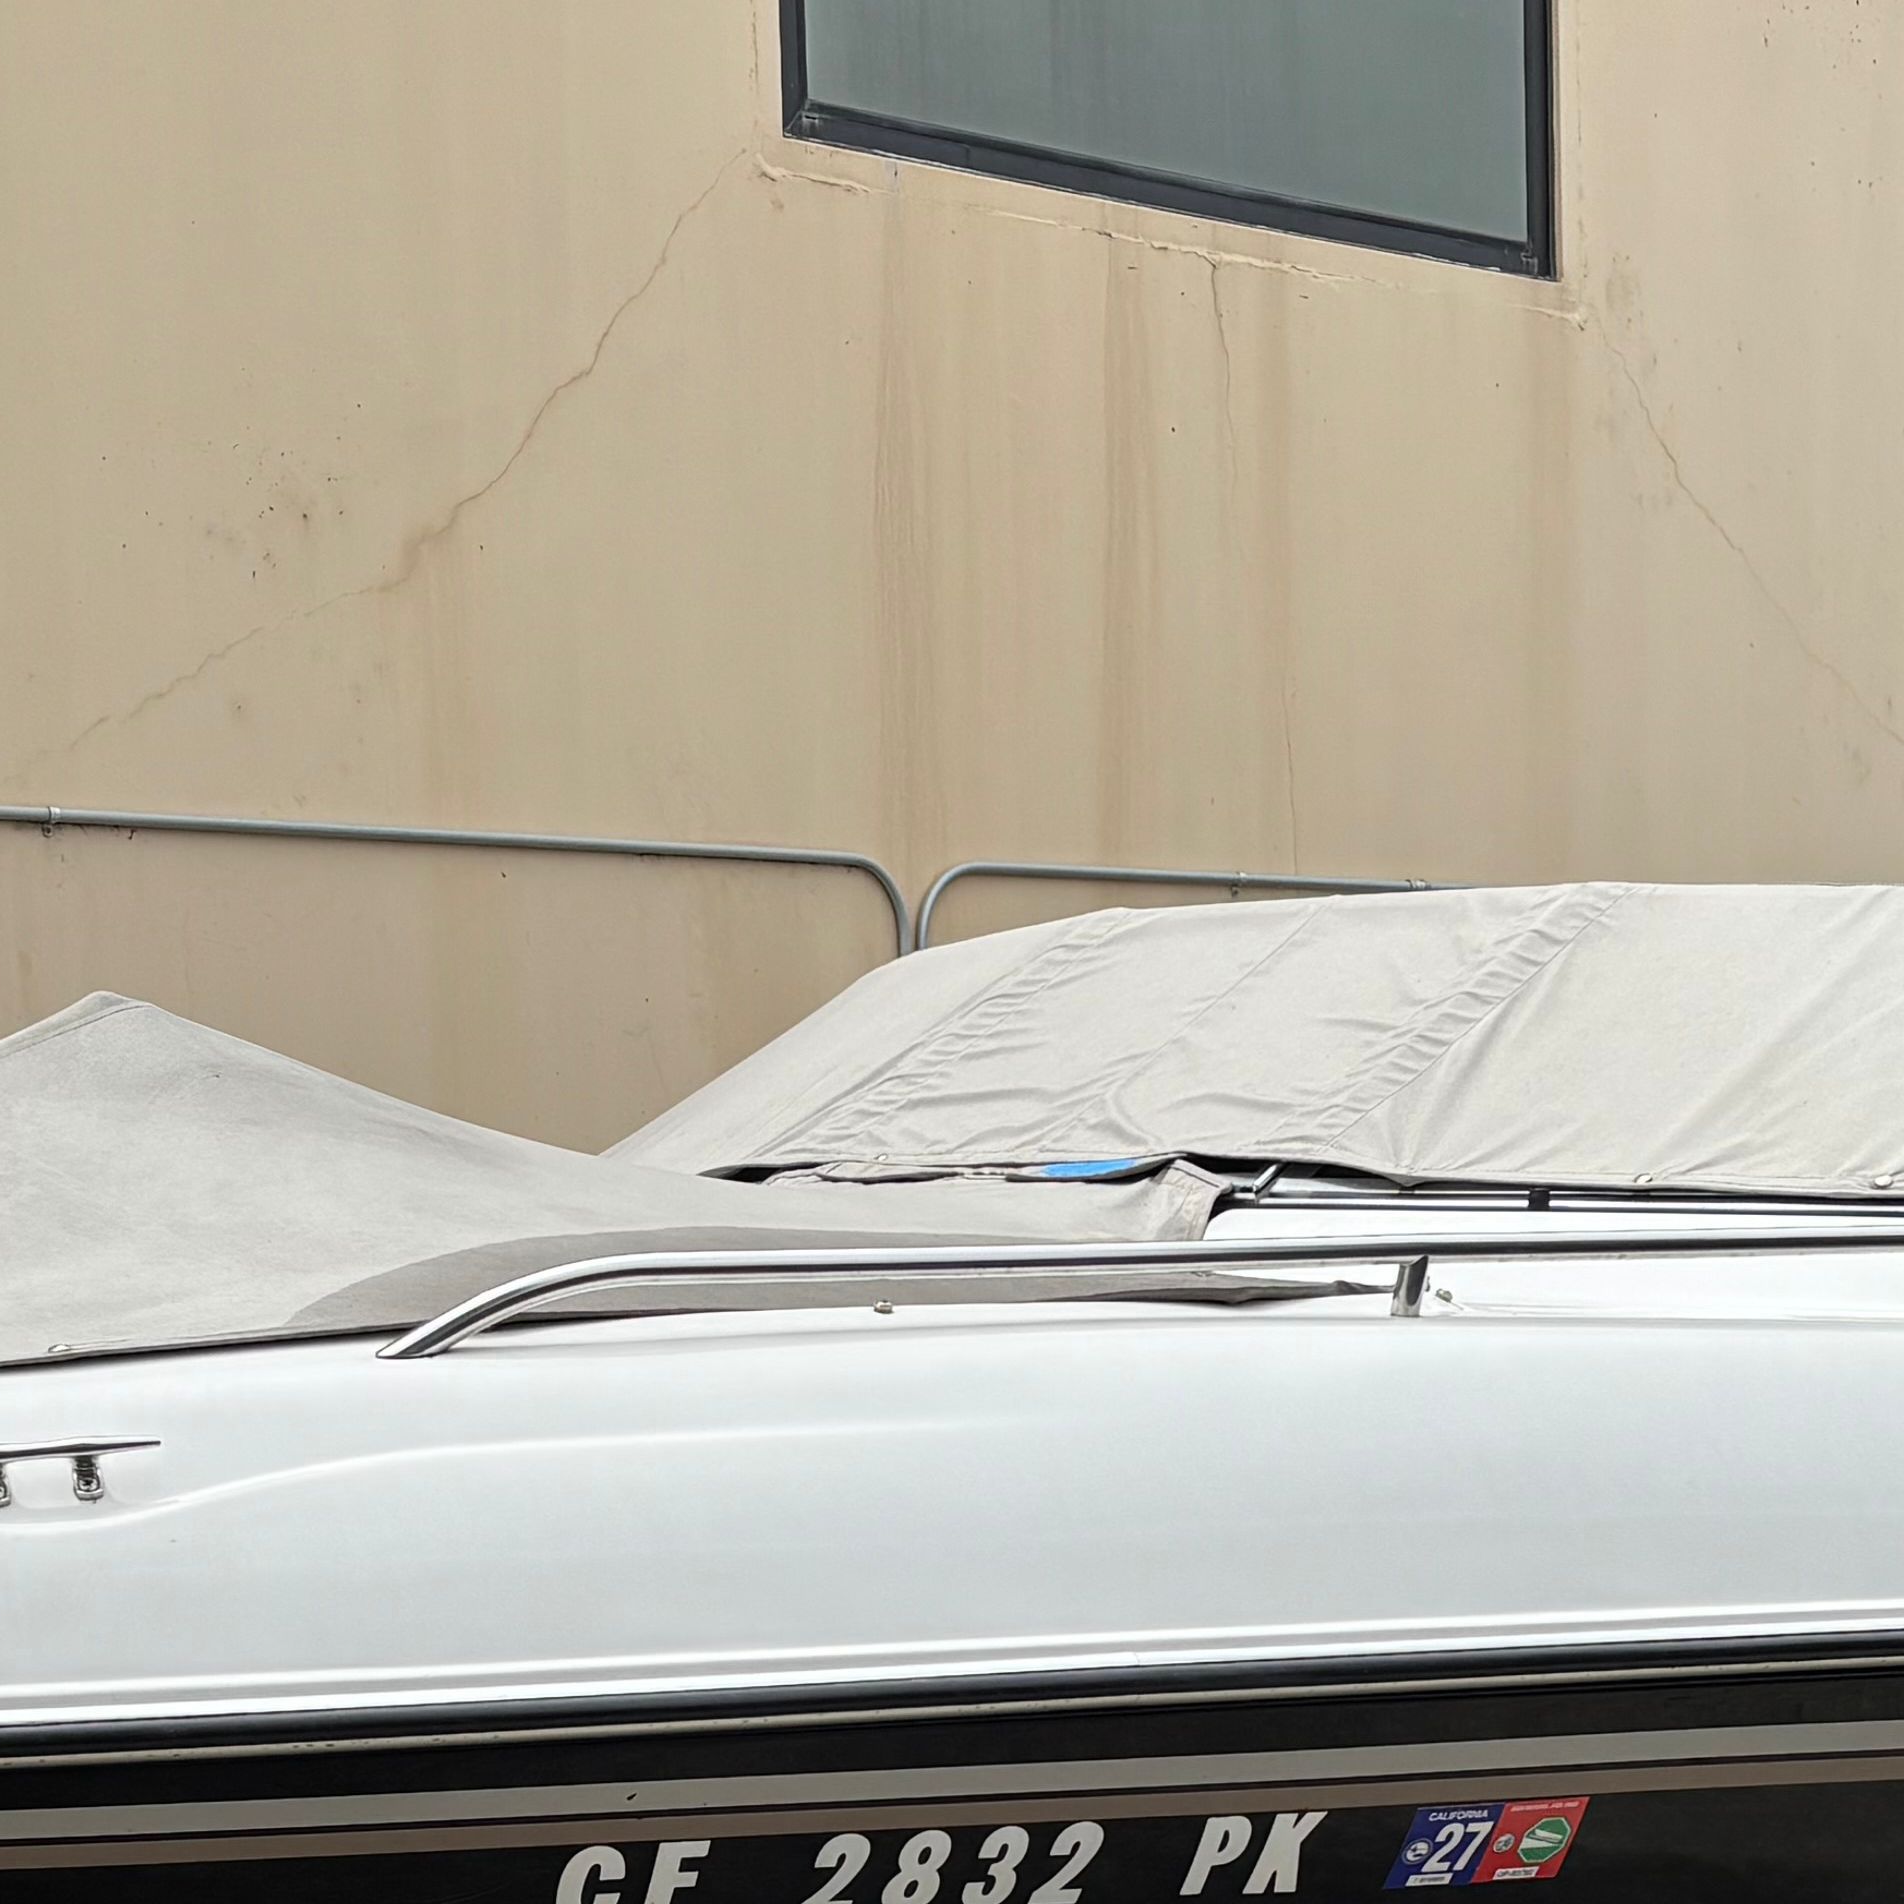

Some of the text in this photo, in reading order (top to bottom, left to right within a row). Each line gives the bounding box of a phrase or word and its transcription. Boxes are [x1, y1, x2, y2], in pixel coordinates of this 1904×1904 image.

[1428, 1810, 1489, 1821] CALIFORNIA
[1179, 1811, 1328, 1896] PK
[1421, 1821, 1494, 1873] 27
